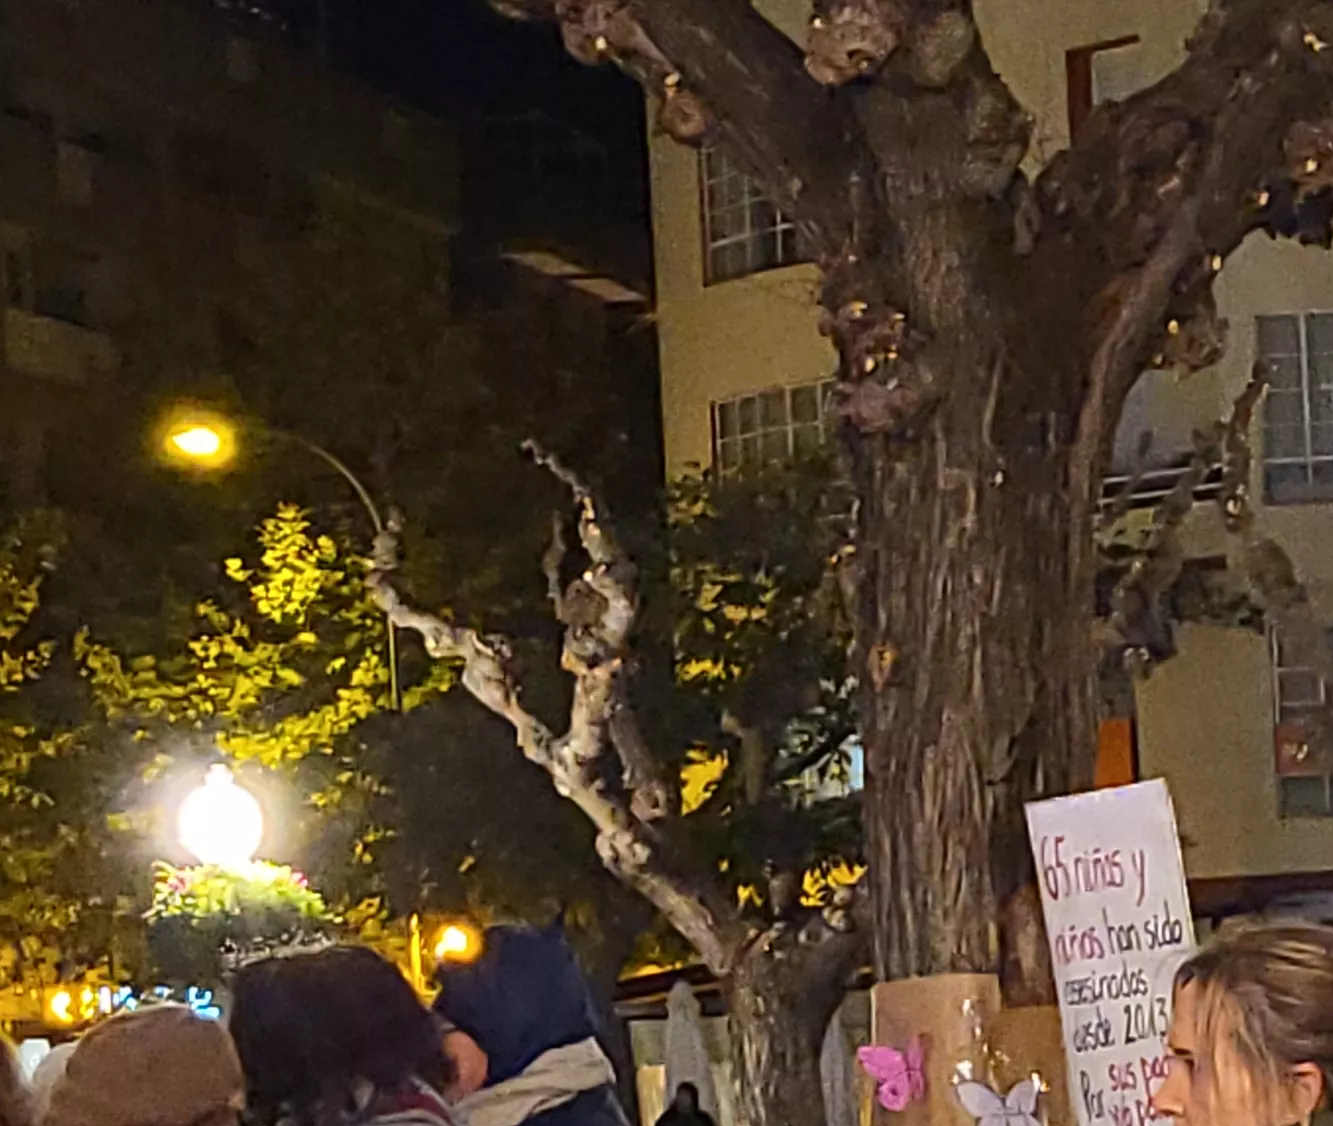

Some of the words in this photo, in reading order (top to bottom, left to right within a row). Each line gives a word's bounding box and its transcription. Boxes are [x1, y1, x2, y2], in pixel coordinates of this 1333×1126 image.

[1041, 834, 1071, 901] 65
[1131, 848, 1146, 907] y
[1102, 905, 1142, 955] han
[1144, 898, 1183, 950] sido
[1123, 996, 1170, 1045] 2013
[1079, 1068, 1105, 1123] Por
[1108, 1059, 1138, 1092] sus
